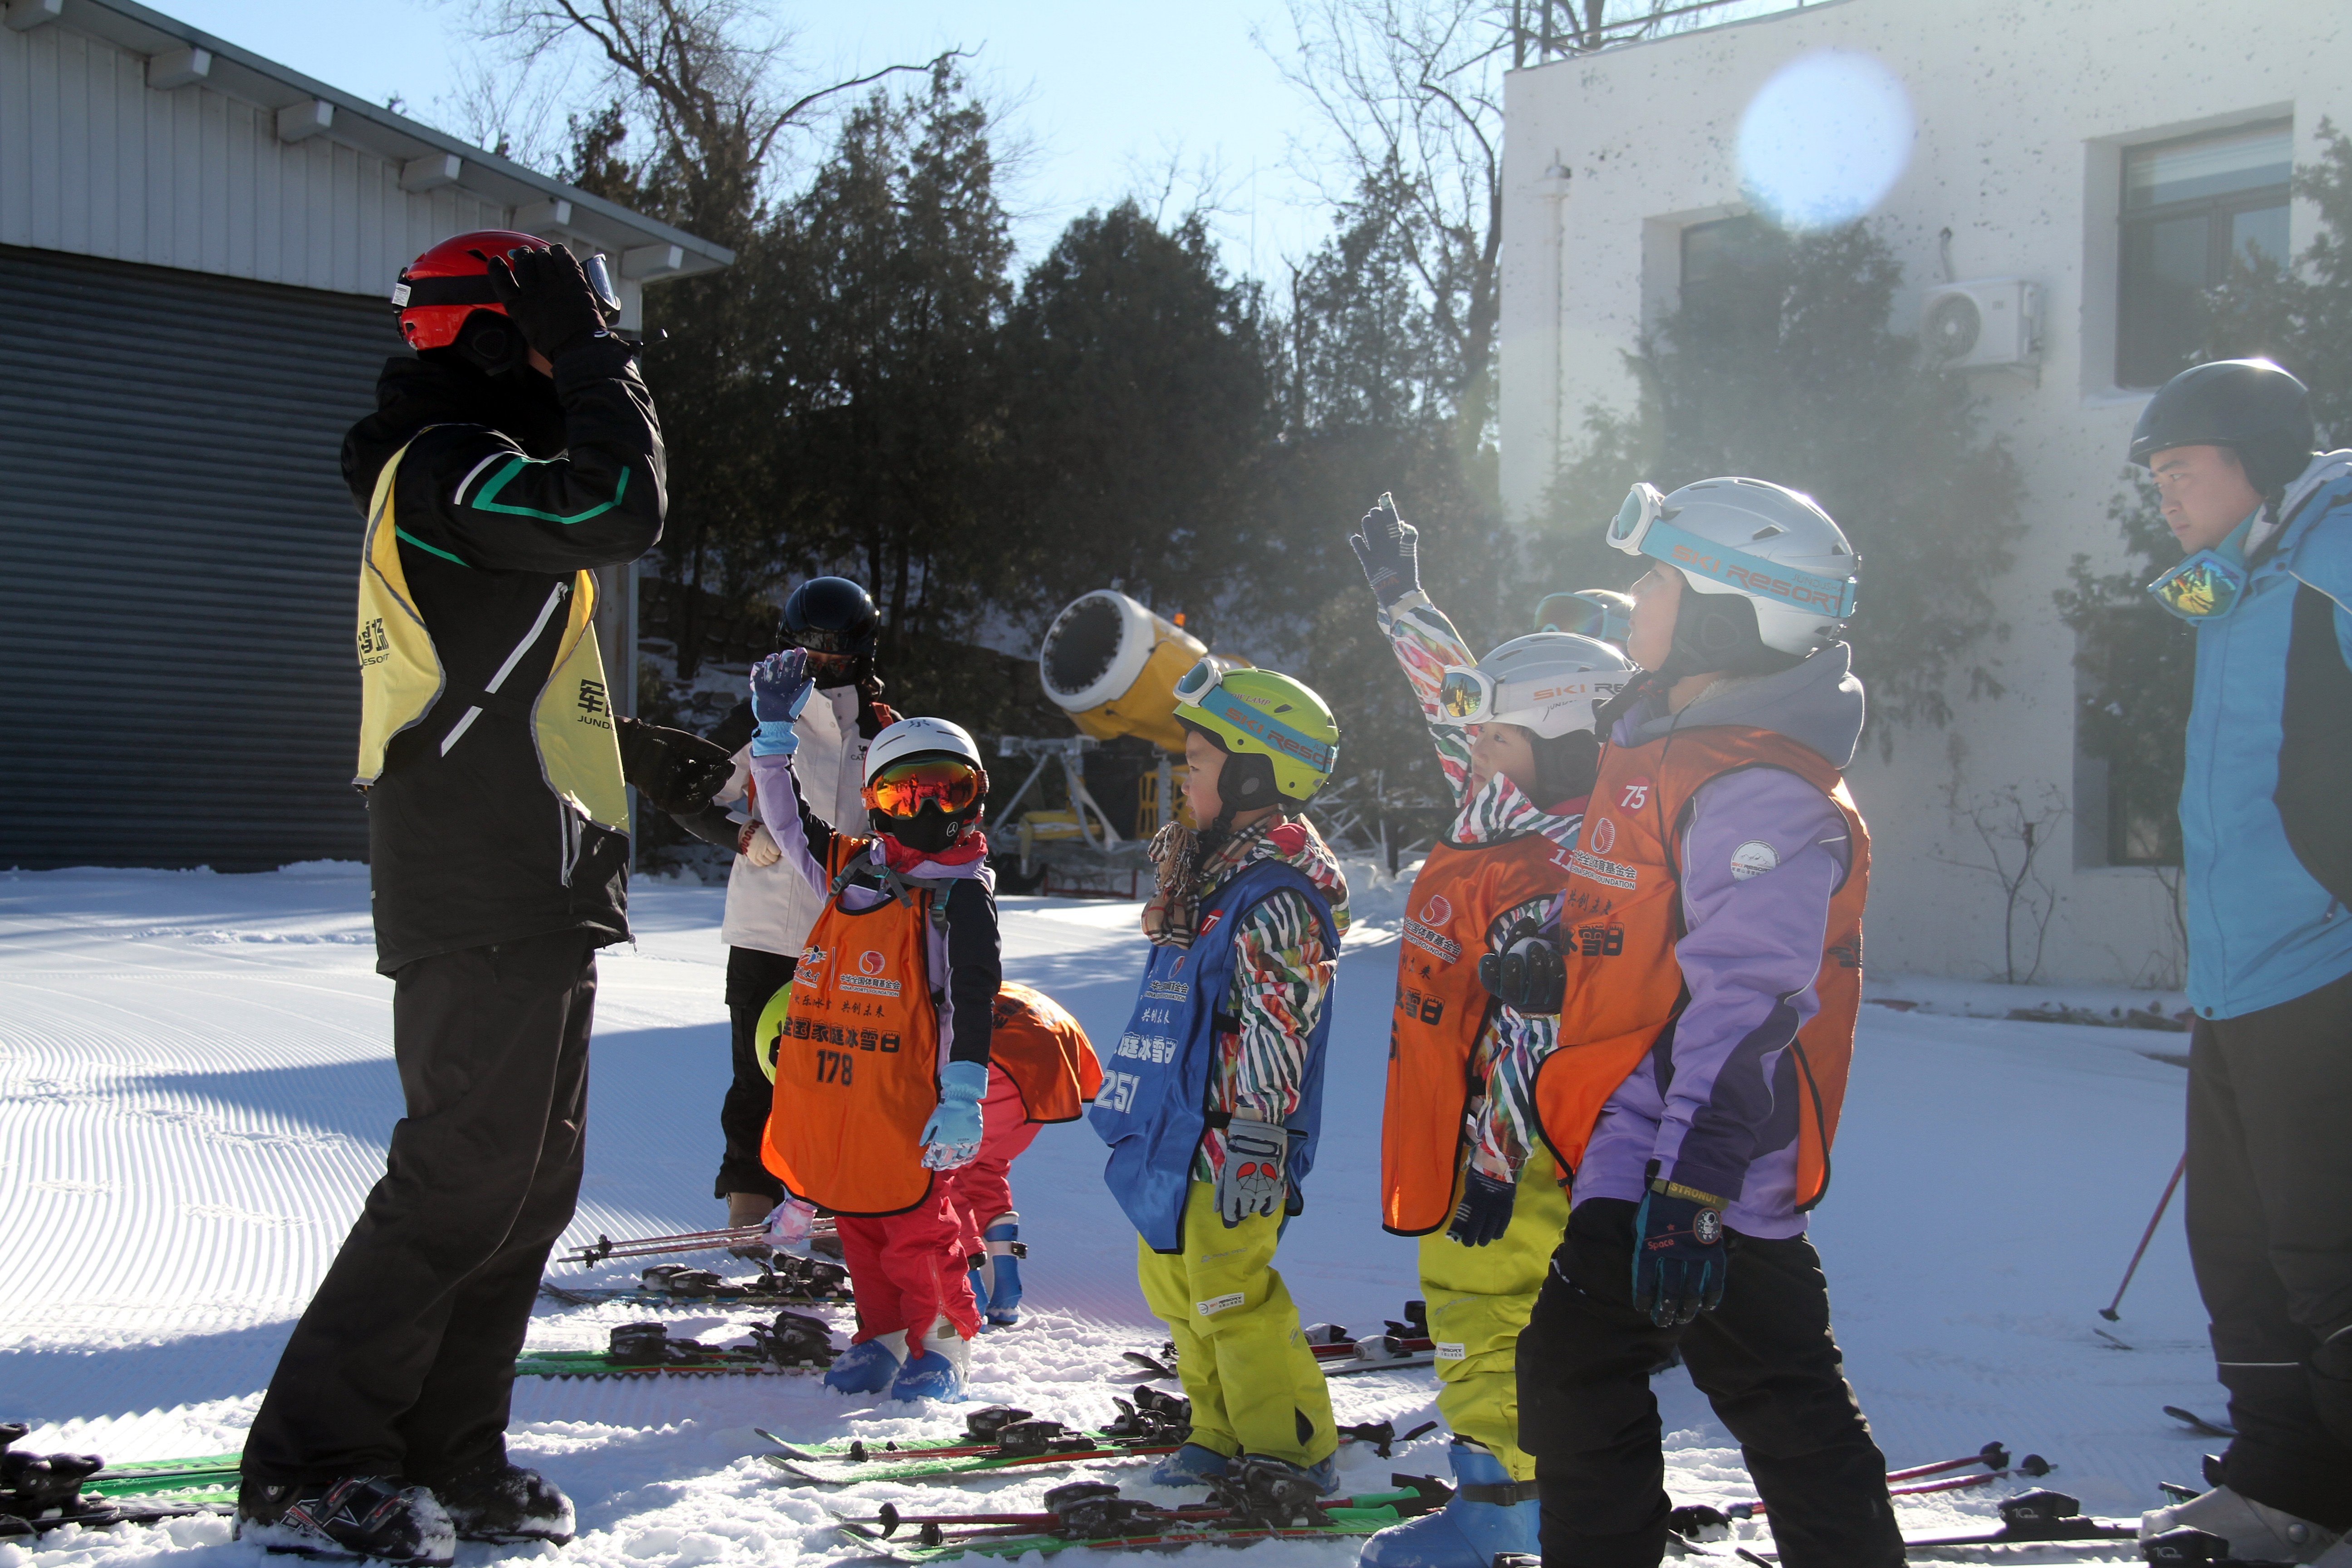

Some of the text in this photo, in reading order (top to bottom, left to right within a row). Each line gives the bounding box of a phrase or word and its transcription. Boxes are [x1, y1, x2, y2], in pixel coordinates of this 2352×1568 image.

[1671, 544, 1720, 573] SKI
[578, 679, 610, 717] 军
[1245, 696, 1271, 706] LAMP
[1533, 683, 1625, 701] SKI RE
[1225, 707, 1264, 734] SKI
[1621, 785, 1648, 809] 75
[1419, 941, 1456, 964] FOUNDATION
[840, 975, 901, 990] 中华全国体育基金会
[841, 1000, 885, 1018] 共创未来
[782, 1013, 901, 1053] 全国家庭冰雪日
[1114, 1031, 1178, 1064] 庭冰雪日
[817, 1049, 853, 1087] 178
[1094, 1069, 1141, 1114] 251
[1647, 1239, 1674, 1251] Space
